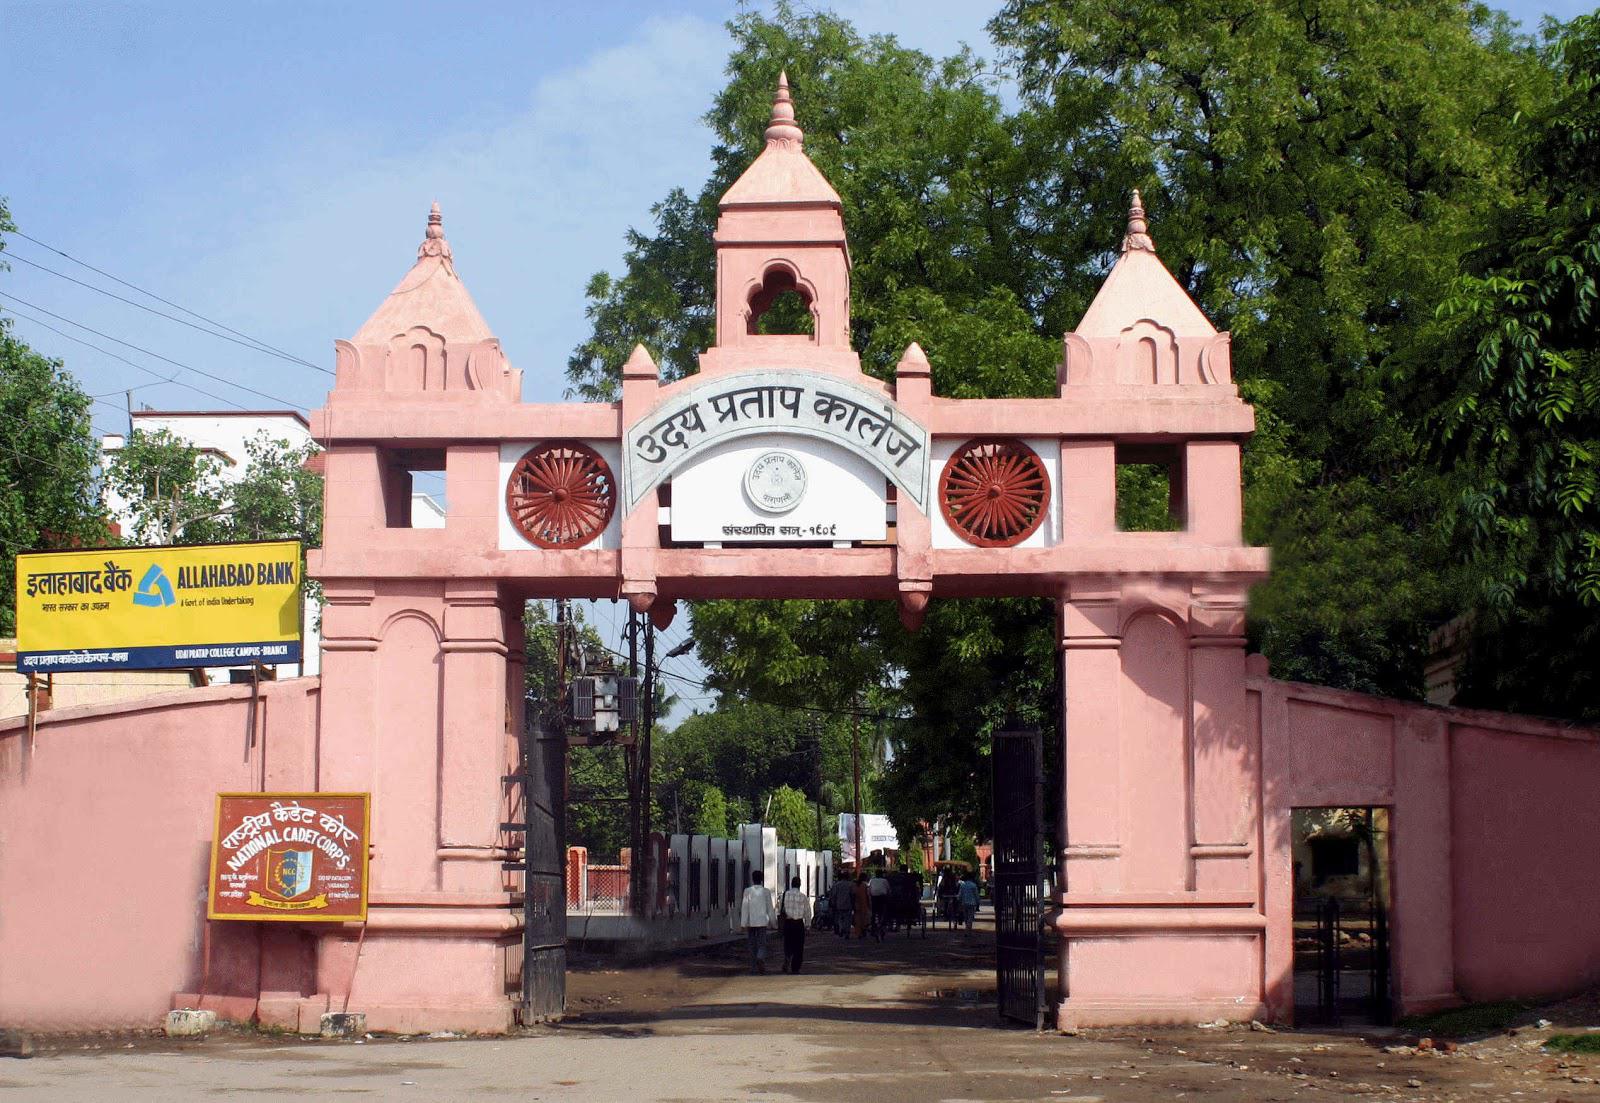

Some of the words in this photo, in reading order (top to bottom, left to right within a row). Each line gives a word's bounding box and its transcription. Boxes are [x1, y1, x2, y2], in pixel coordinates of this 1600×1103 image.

[636, 403, 706, 464] उदय
[708, 386, 805, 423] प्रताप
[814, 390, 922, 468] कालेज
[752, 463, 765, 480] उदय
[763, 456, 785, 466] प्रताप
[722, 523, 775, 536] संस्थापित
[26, 570, 103, 598] इलाहाबाद
[104, 561, 133, 592] बैंक
[177, 563, 255, 589] ALLAHABAD
[257, 561, 295, 586] BANK
[199, 597, 205, 606] of
[189, 648, 209, 659] PRATAP
[209, 647, 235, 658] COLLEGE
[221, 812, 272, 849] राष्ट्रीय
[270, 801, 317, 824] कैडेट
[320, 814, 359, 847] कोर
[226, 829, 283, 871] NATIONAL
[283, 827, 320, 845] CADET
[317, 835, 351, 869] CORPS
